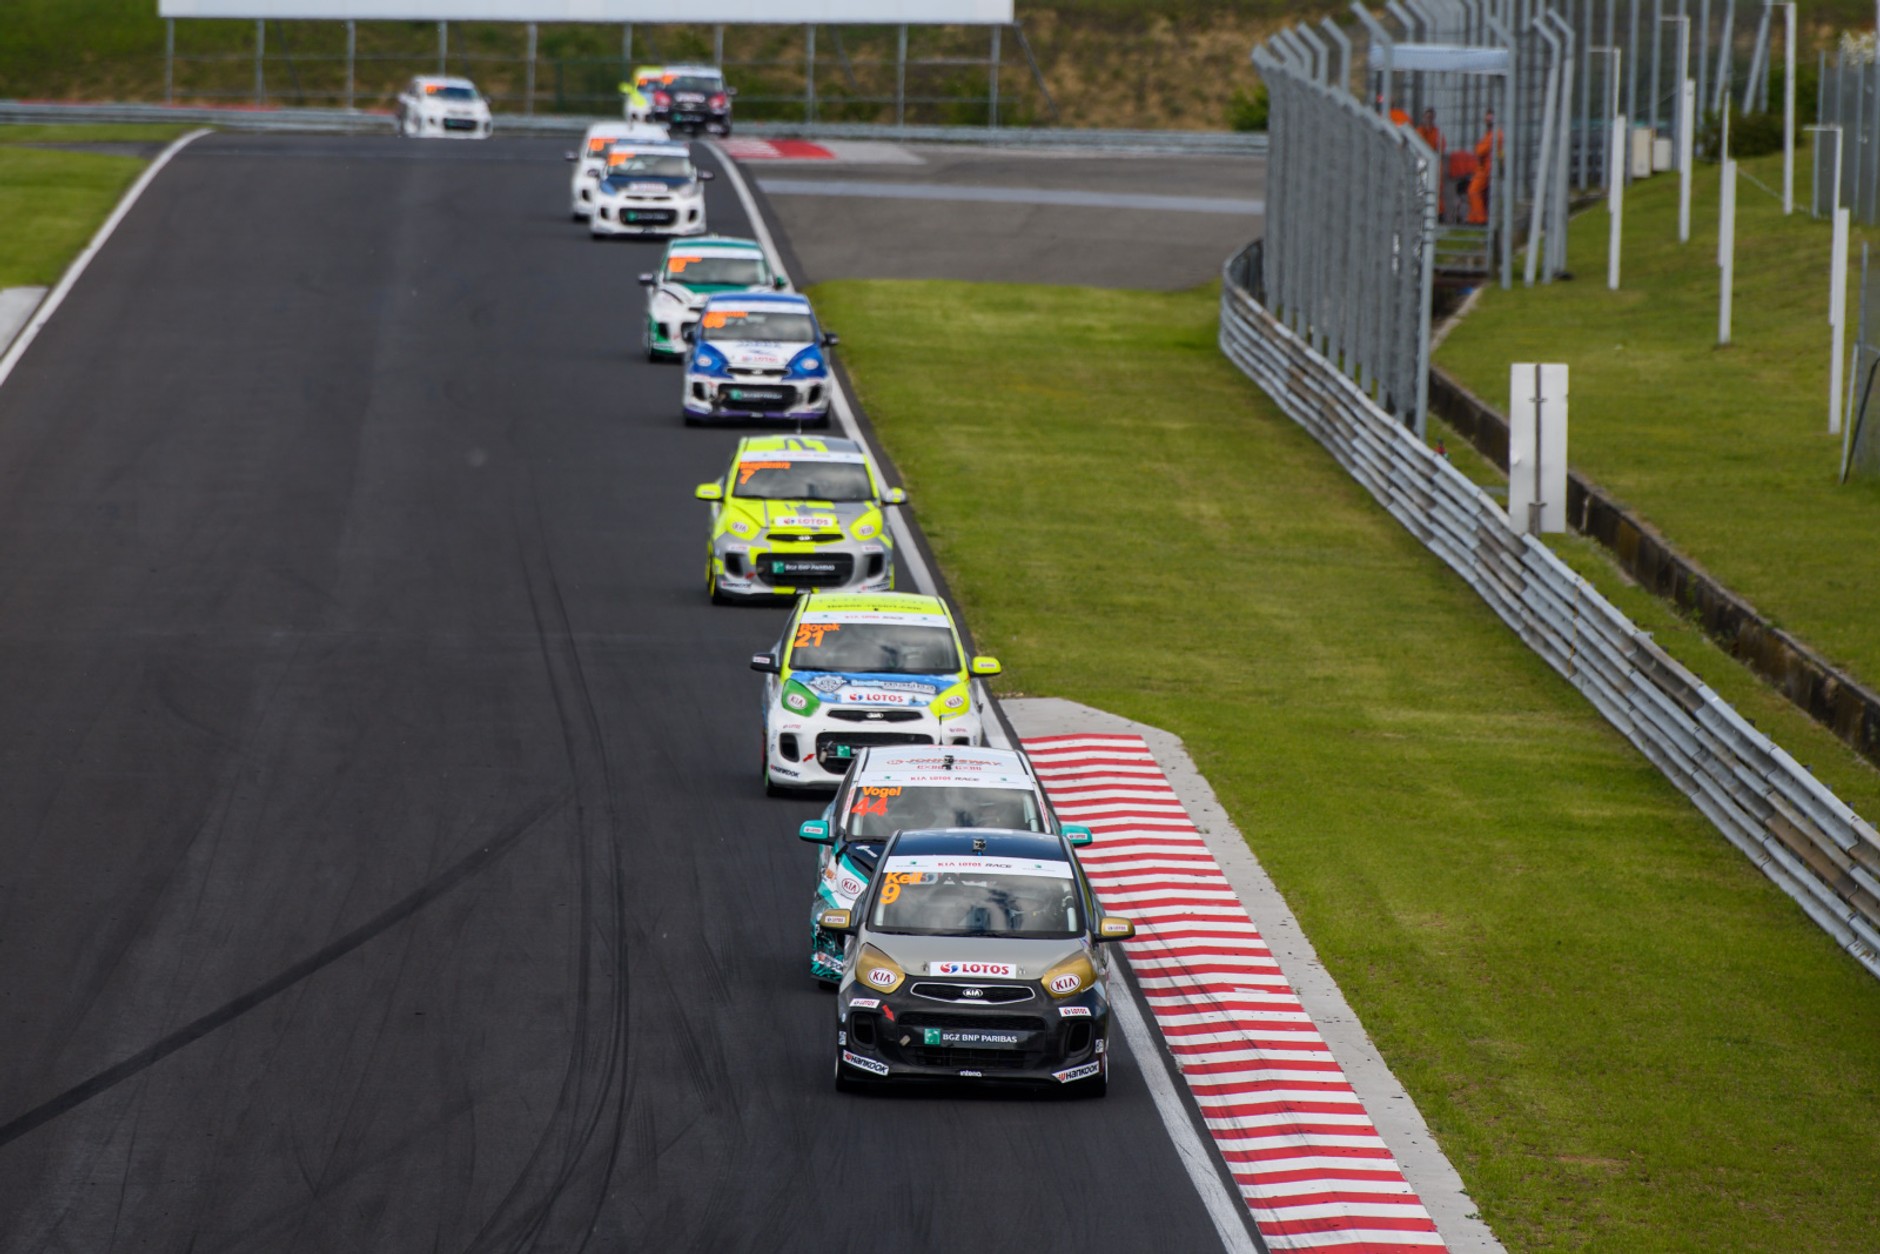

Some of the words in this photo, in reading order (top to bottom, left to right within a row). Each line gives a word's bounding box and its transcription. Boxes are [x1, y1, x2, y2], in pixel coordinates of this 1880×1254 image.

[739, 468, 756, 485] 7
[800, 622, 841, 632] Borek
[793, 630, 825, 648] 21
[790, 696, 803, 707] KIA
[866, 693, 904, 702] LOTOS
[948, 696, 962, 706] KIA
[862, 786, 903, 798] Vogel
[851, 796, 888, 816] 44
[842, 881, 858, 893] KIA
[880, 883, 901, 905] 9
[962, 963, 1010, 975] LOTOS
[872, 970, 892, 983] KIA
[1055, 977, 1077, 991] KIA
[965, 989, 982, 997] KIA
[1070, 1007, 1088, 1015] LOTOS
[962, 1034, 980, 1042] BNP
[981, 1035, 1018, 1043] PARIBAS
